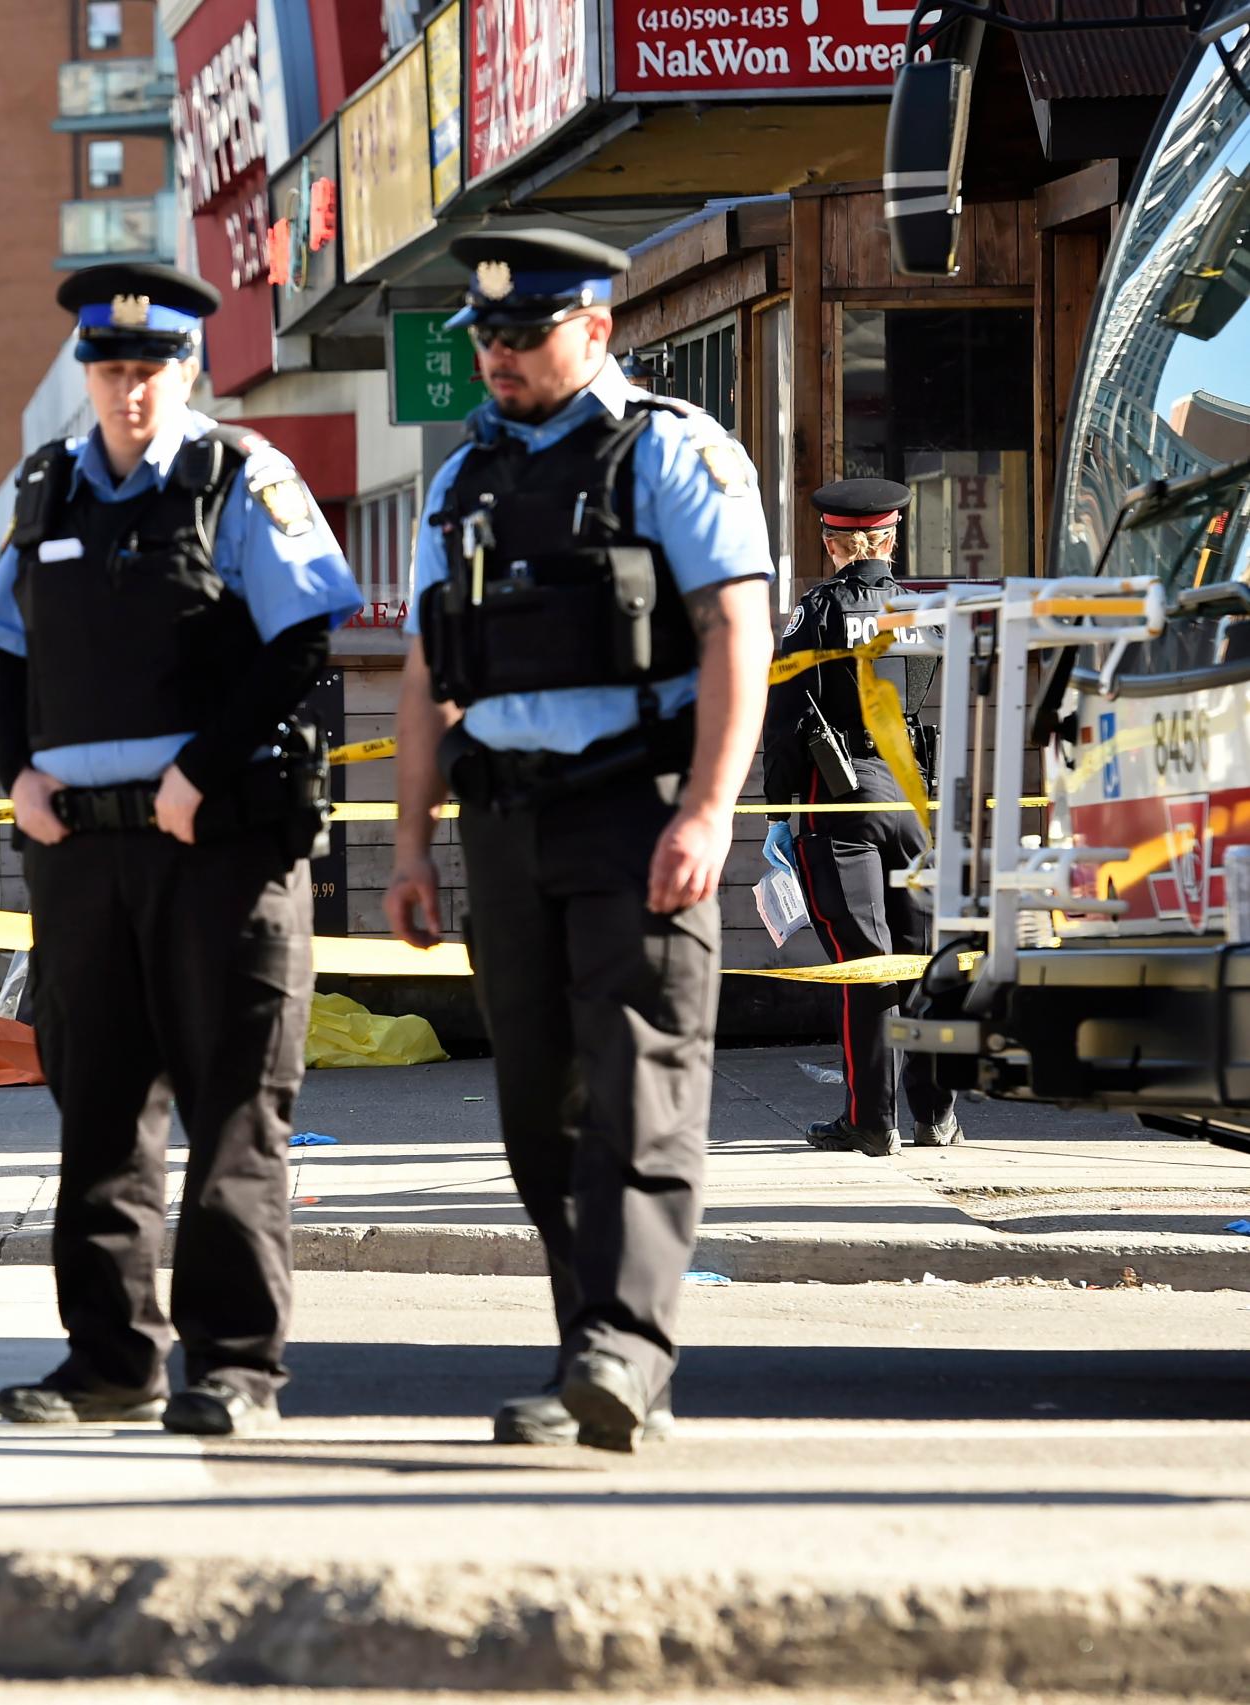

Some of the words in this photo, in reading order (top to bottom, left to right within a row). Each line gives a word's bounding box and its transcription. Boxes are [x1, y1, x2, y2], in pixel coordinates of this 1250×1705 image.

[637, 7, 789, 31] (416)590-1435
[636, 38, 790, 78] NakWon
[426, 321, 454, 408] 노래방
[846, 617, 925, 648] POIC
[1154, 708, 1211, 776] 8456
[312, 882, 335, 898] 9.99
